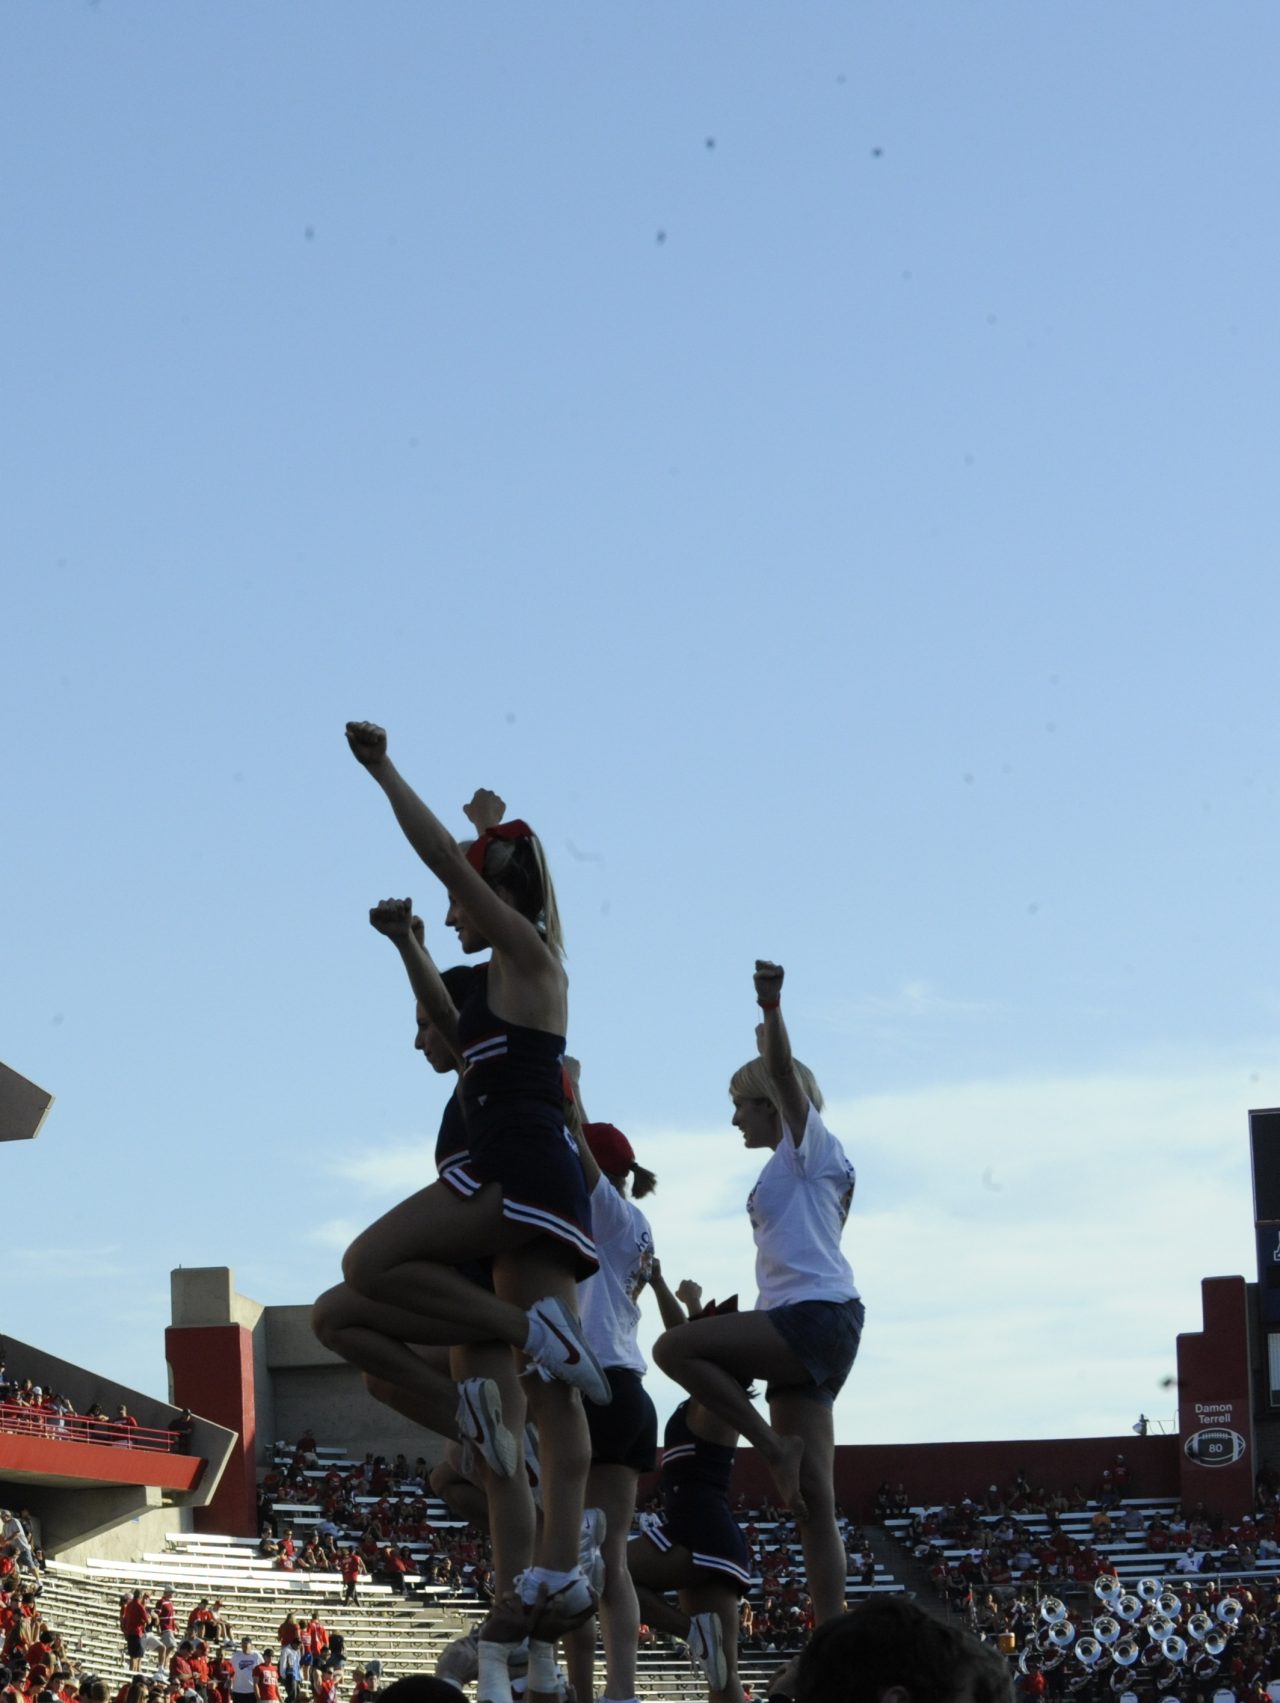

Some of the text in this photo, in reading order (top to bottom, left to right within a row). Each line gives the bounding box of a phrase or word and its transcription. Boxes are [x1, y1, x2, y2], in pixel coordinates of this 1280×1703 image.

[1195, 1404, 1232, 1413] Damon
[1199, 1413, 1231, 1424] Terrell
[1209, 1444, 1223, 1453] 80
